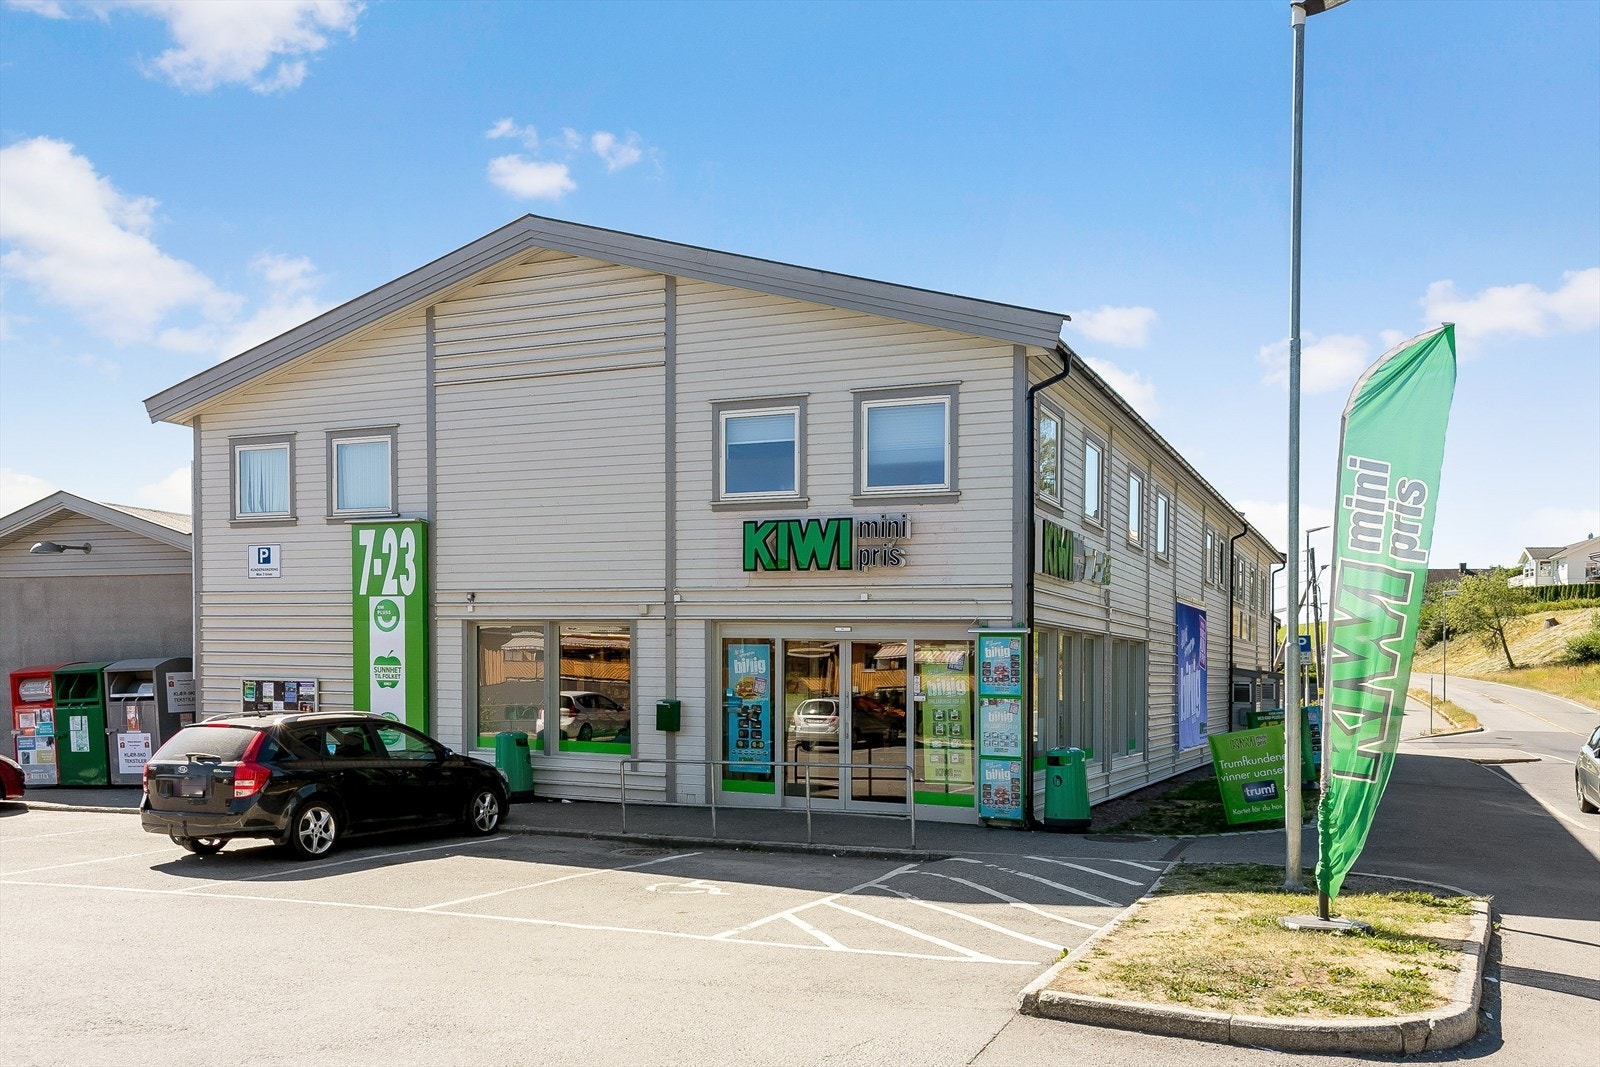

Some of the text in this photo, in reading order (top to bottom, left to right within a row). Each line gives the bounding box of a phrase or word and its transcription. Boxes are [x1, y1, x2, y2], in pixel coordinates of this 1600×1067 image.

[1343, 455, 1391, 554] mini
[858, 513, 910, 539] mini
[1386, 476, 1428, 563] pris
[259, 548, 269, 563] P
[743, 517, 853, 571] KIWI
[359, 527, 416, 596] 7-23
[858, 543, 904, 572] pris
[985, 646, 1010, 658] billig
[734, 657, 766, 674] billig
[1332, 557, 1414, 784] KIWI
[927, 677, 966, 697] billig
[1230, 736, 1256, 750] KIWI
[1220, 772, 1250, 782] vinner
[1246, 784, 1276, 796] trumf
